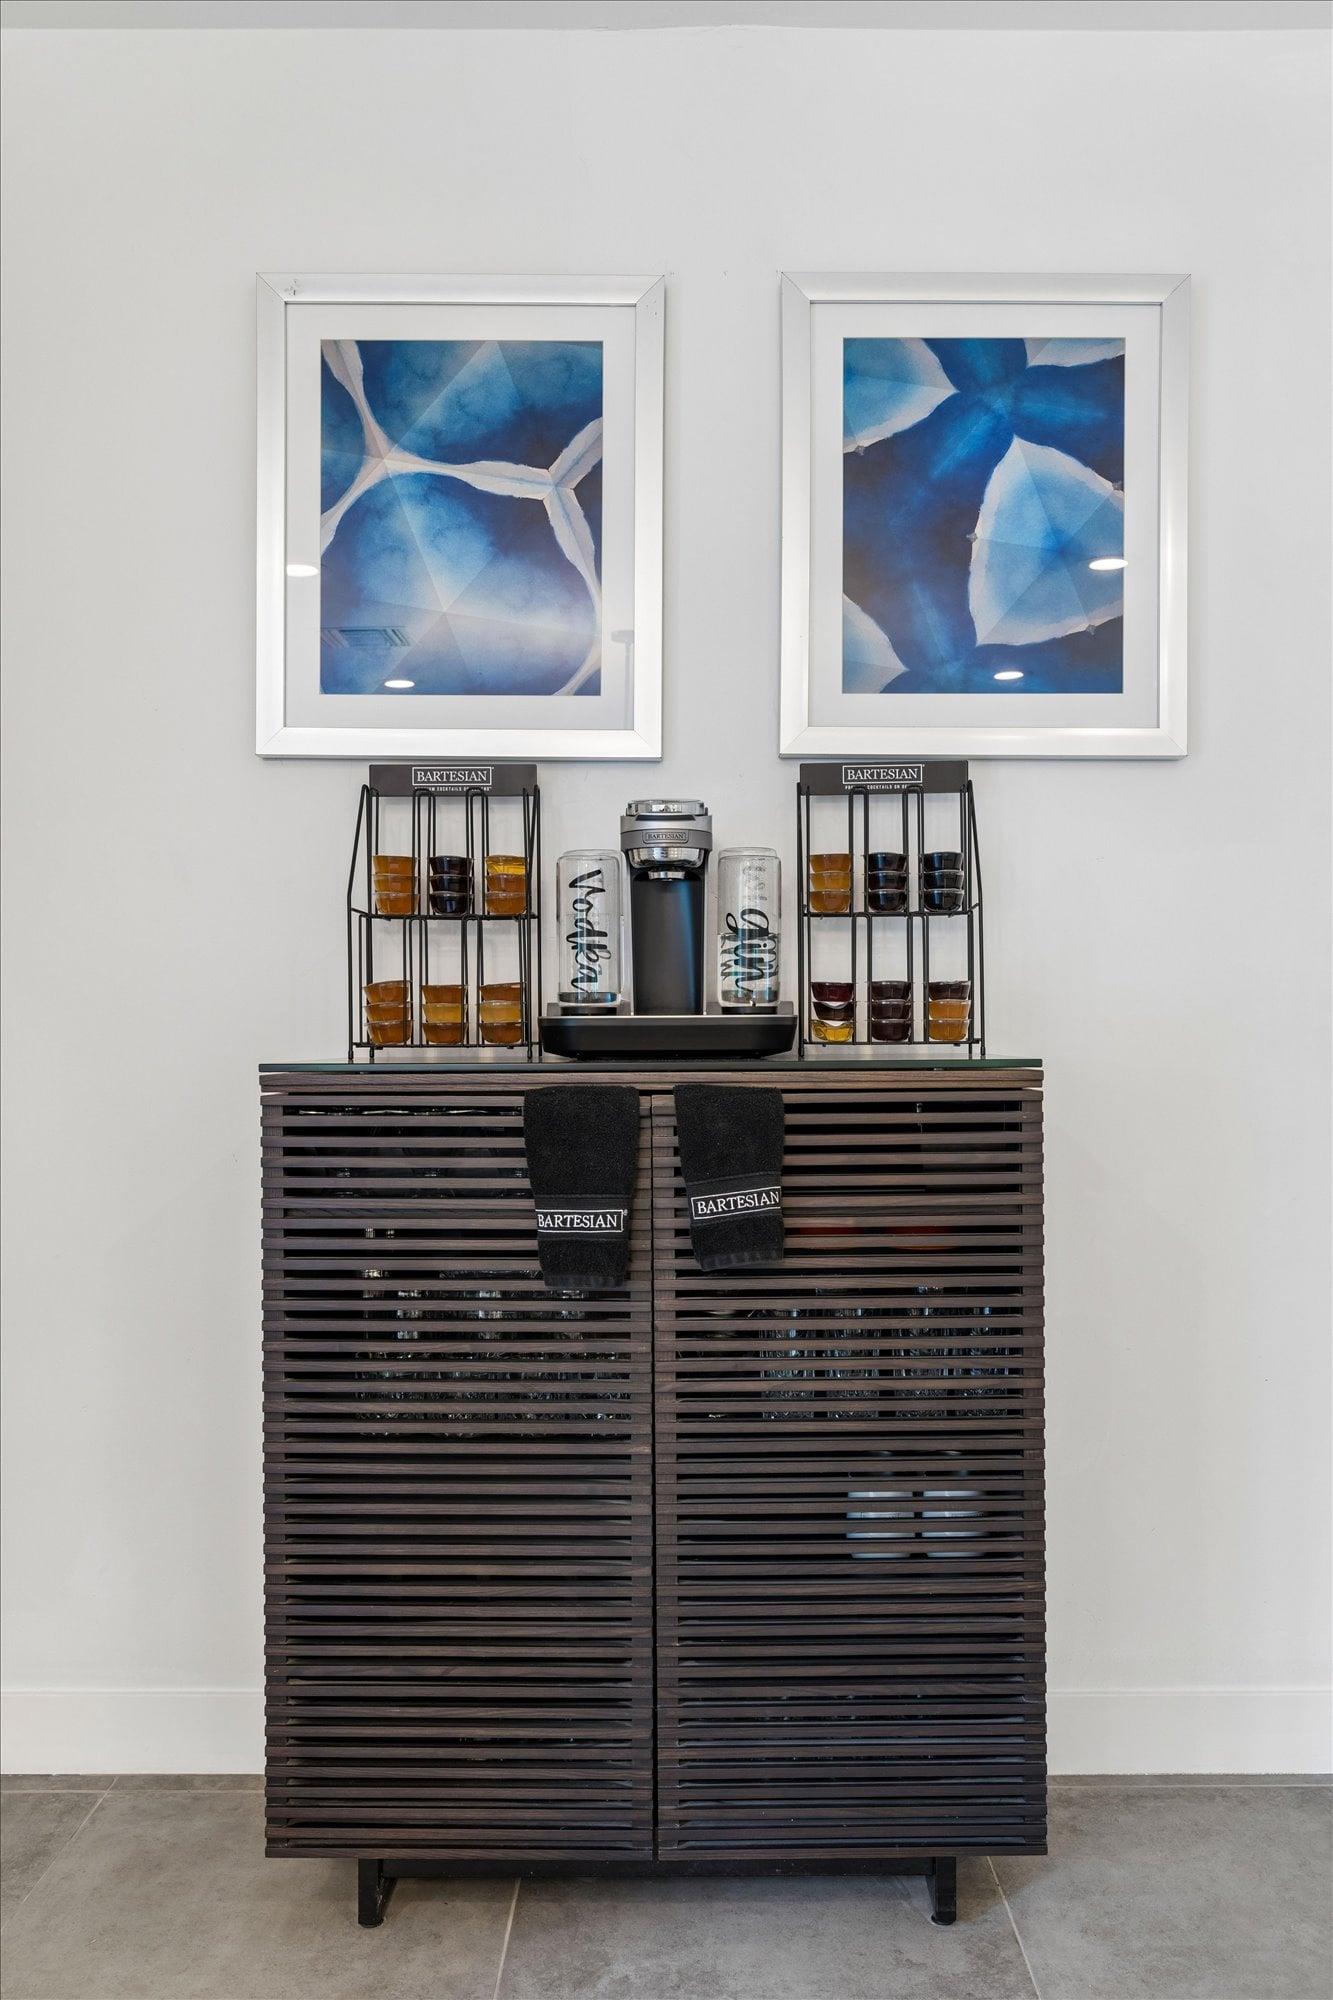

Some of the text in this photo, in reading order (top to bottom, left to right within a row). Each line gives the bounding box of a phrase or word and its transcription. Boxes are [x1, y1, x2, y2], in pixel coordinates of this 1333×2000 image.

[416, 770, 487, 782] BARTESIAN
[847, 768, 919, 780] BARTESIAN
[696, 1191, 780, 1215] BARTESIAN
[537, 1214, 618, 1228] BARTESIAN
